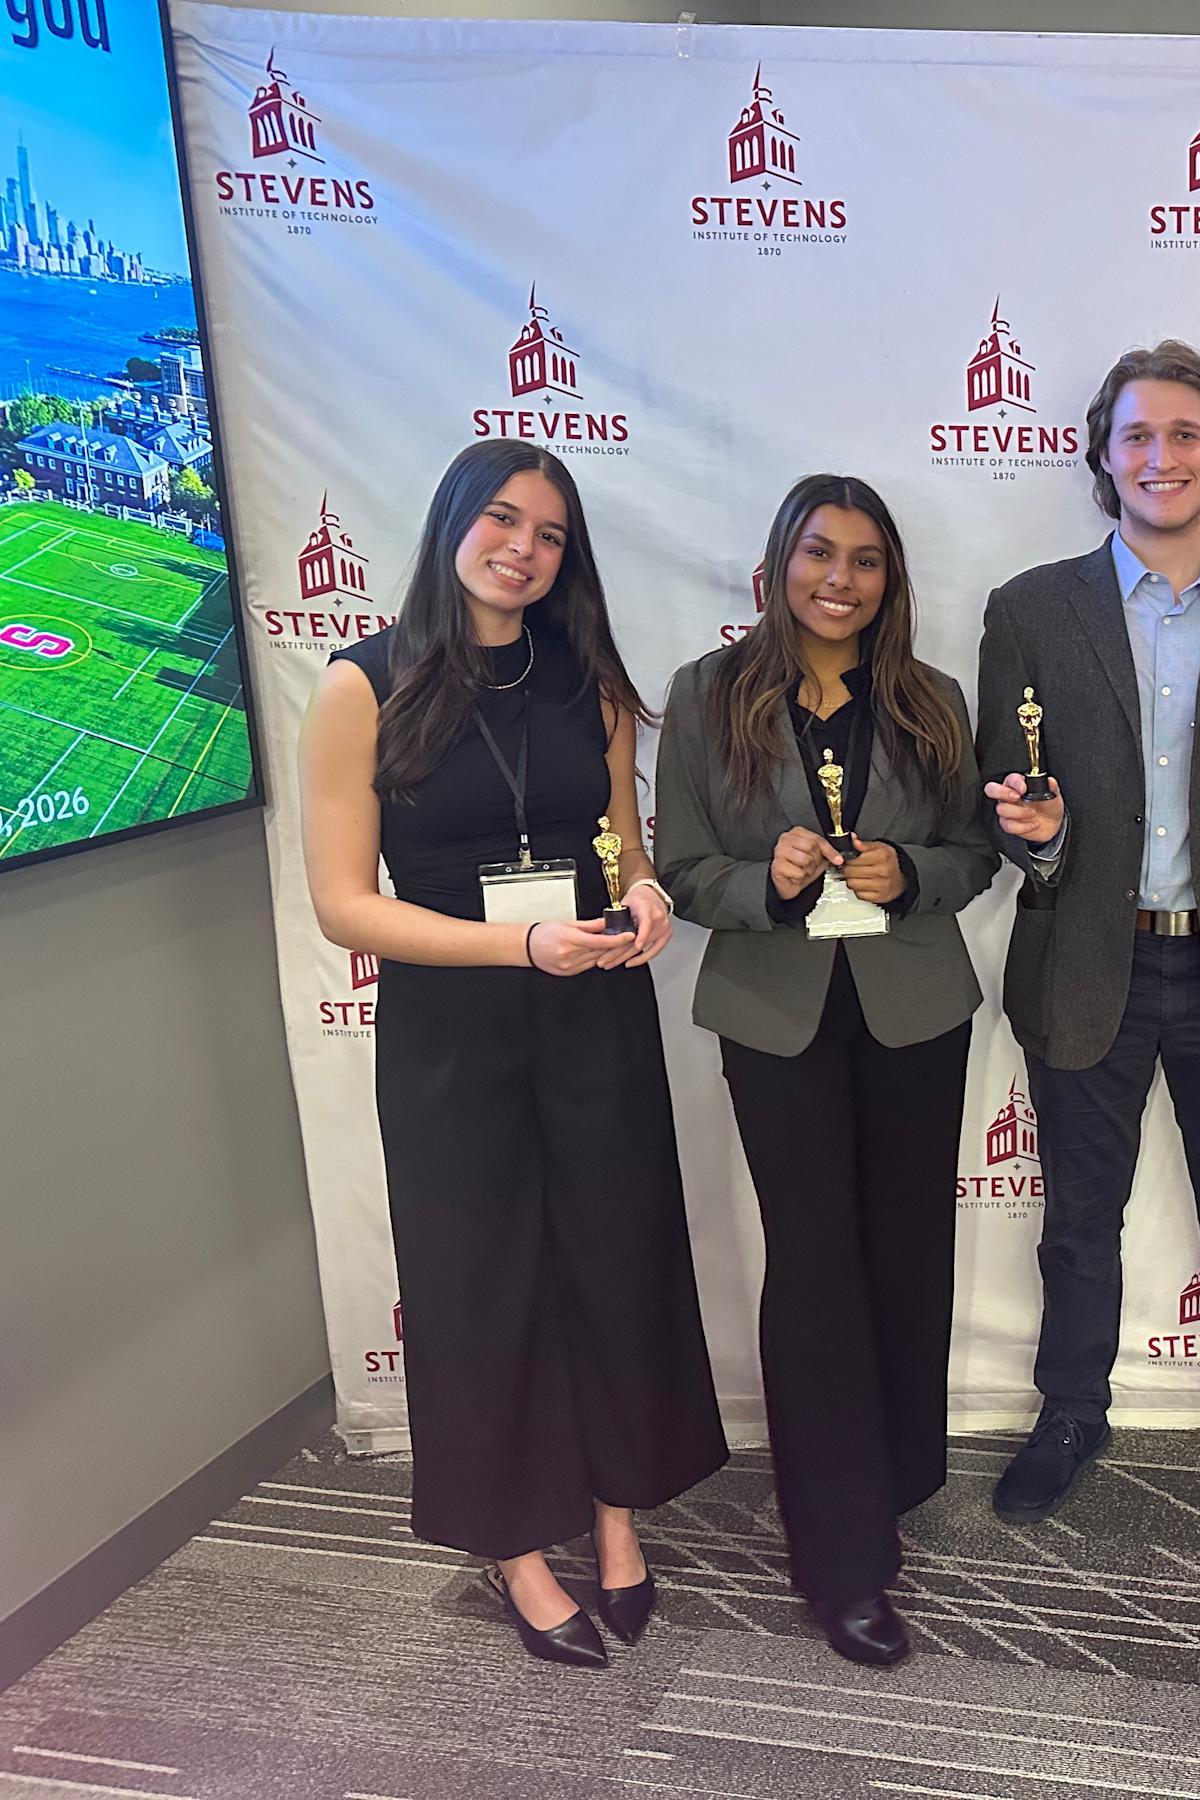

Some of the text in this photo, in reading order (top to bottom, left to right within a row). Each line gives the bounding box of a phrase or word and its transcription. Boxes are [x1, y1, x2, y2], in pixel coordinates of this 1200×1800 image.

[215, 171, 374, 210] STEVENS
[219, 206, 378, 224] INSTITUTE OF TECHNOLOGY
[691, 197, 847, 229] STEVENS
[287, 225, 311, 235] 1870
[692, 231, 847, 243] INSTITUTE OF TECHNOLOGY
[757, 248, 782, 256] 1870
[473, 409, 628, 442] STEVENS
[930, 424, 1078, 454] STEVENS
[555, 445, 629, 456] TECHNOLOGY
[931, 457, 1078, 468] INSTITUTE OF TECHNOLOGY
[992, 472, 1016, 480] 1870
[265, 610, 398, 639] STEVEN
[269, 641, 325, 651] INSTITUTE
[18, 786, 90, 828] 2026
[322, 1029, 372, 1038] INSTITUTE
[956, 1176, 1044, 1198] STEVE
